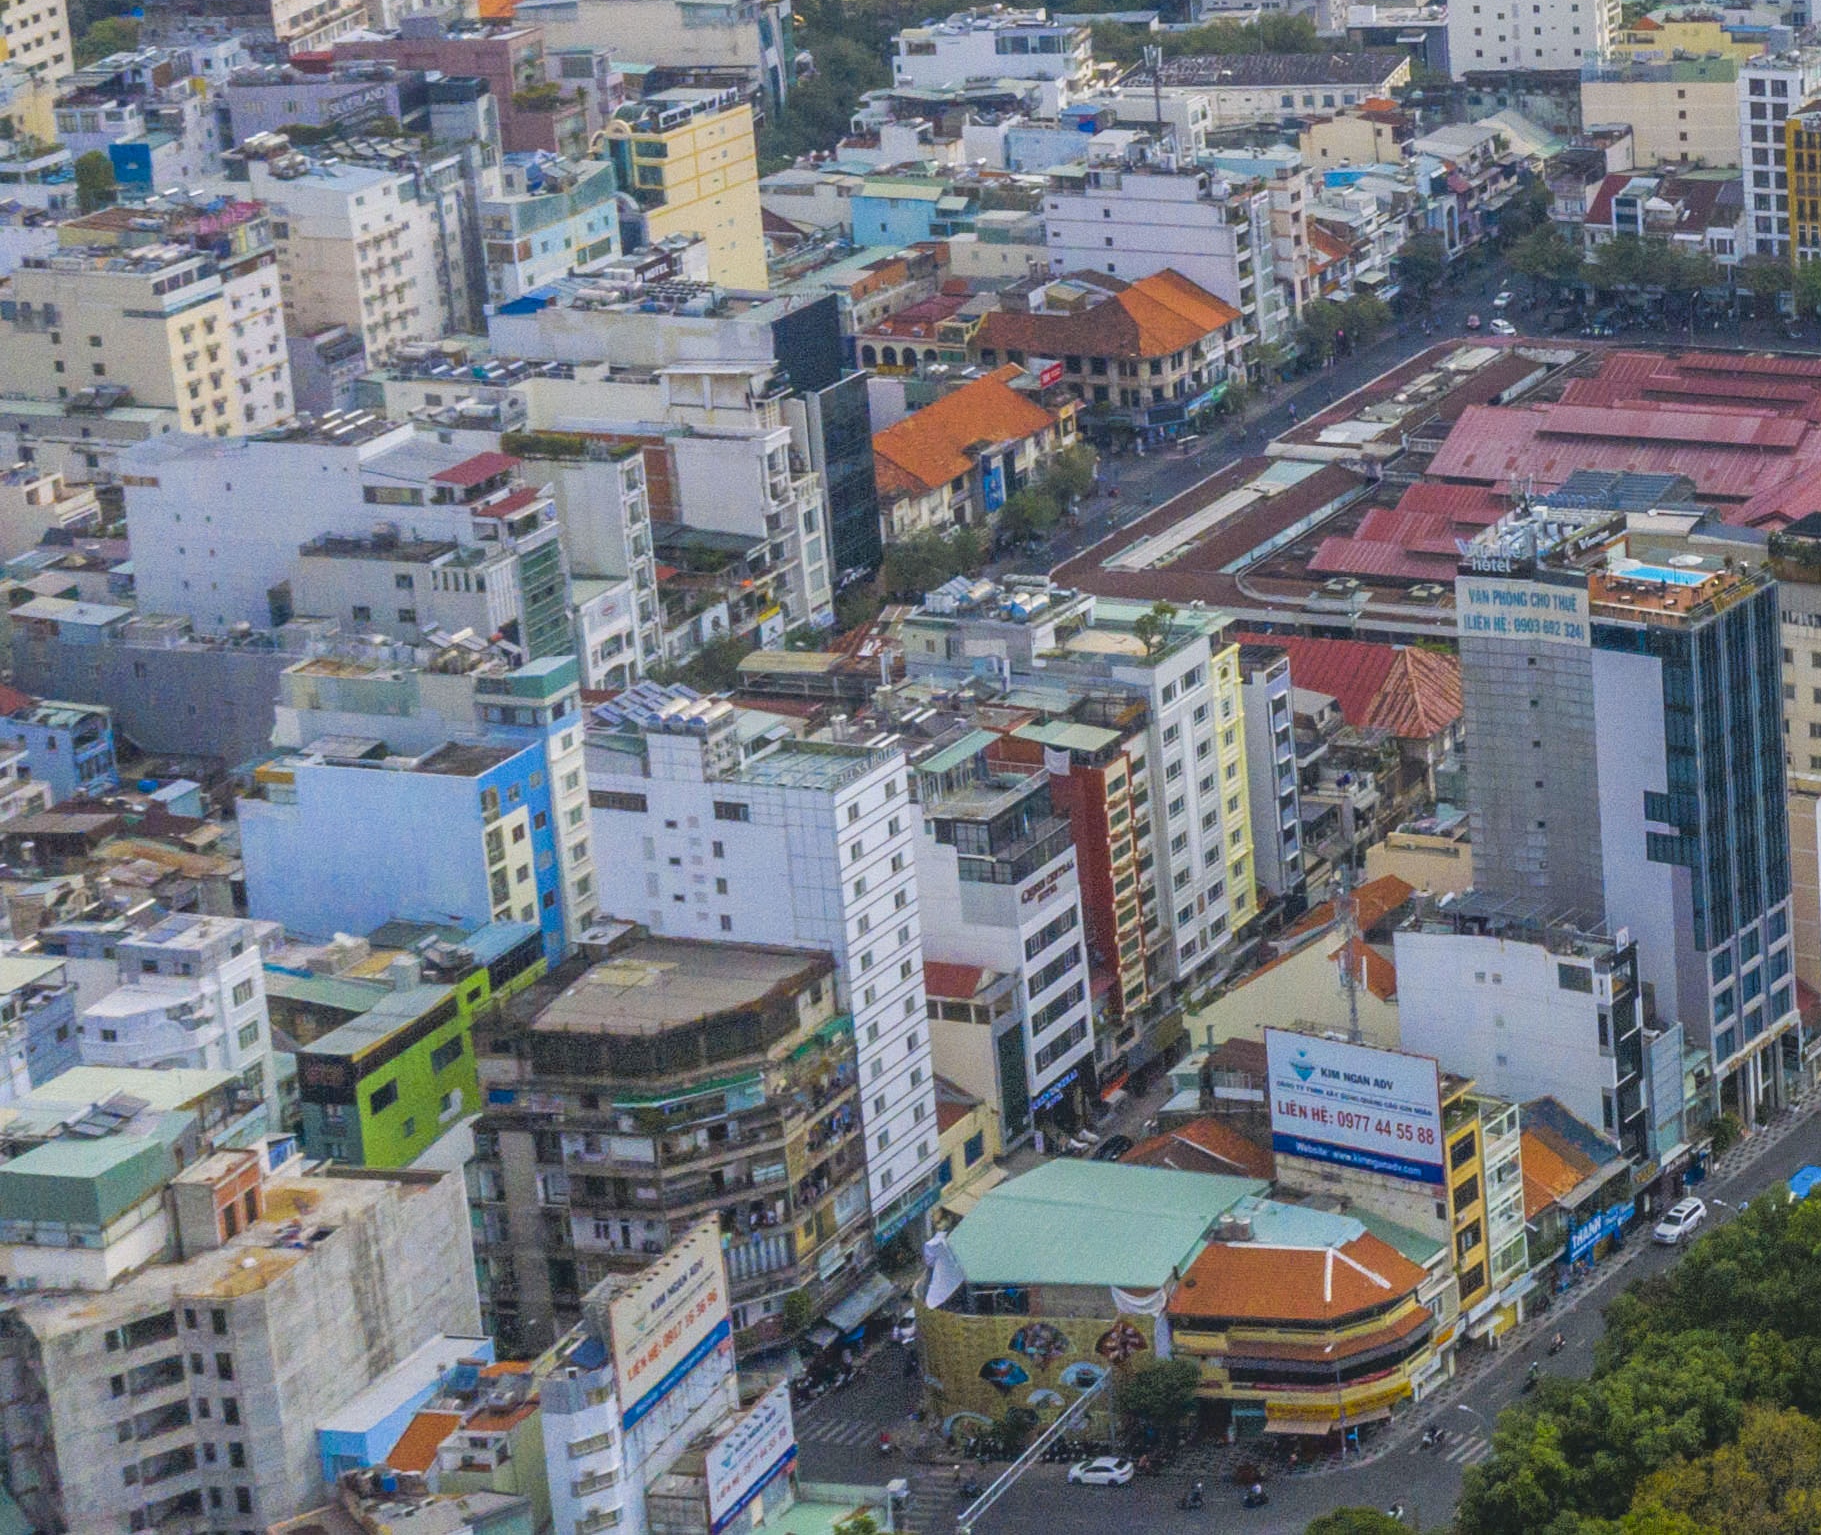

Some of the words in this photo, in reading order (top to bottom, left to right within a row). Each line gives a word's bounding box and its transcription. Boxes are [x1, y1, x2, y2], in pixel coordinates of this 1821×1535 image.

[1472, 557, 1512, 573] hotel
[1530, 592, 1550, 609] CHO
[1320, 1067, 1341, 1081] KIM
[1343, 1071, 1371, 1087] NGAN
[1373, 1077, 1394, 1091] ADV
[1277, 1099, 1308, 1120] LIÊN
[1337, 1110, 1371, 1133] 0977
[1375, 1118, 1393, 1138] 44
[1396, 1122, 1414, 1142] 55
[1417, 1126, 1435, 1146] 88
